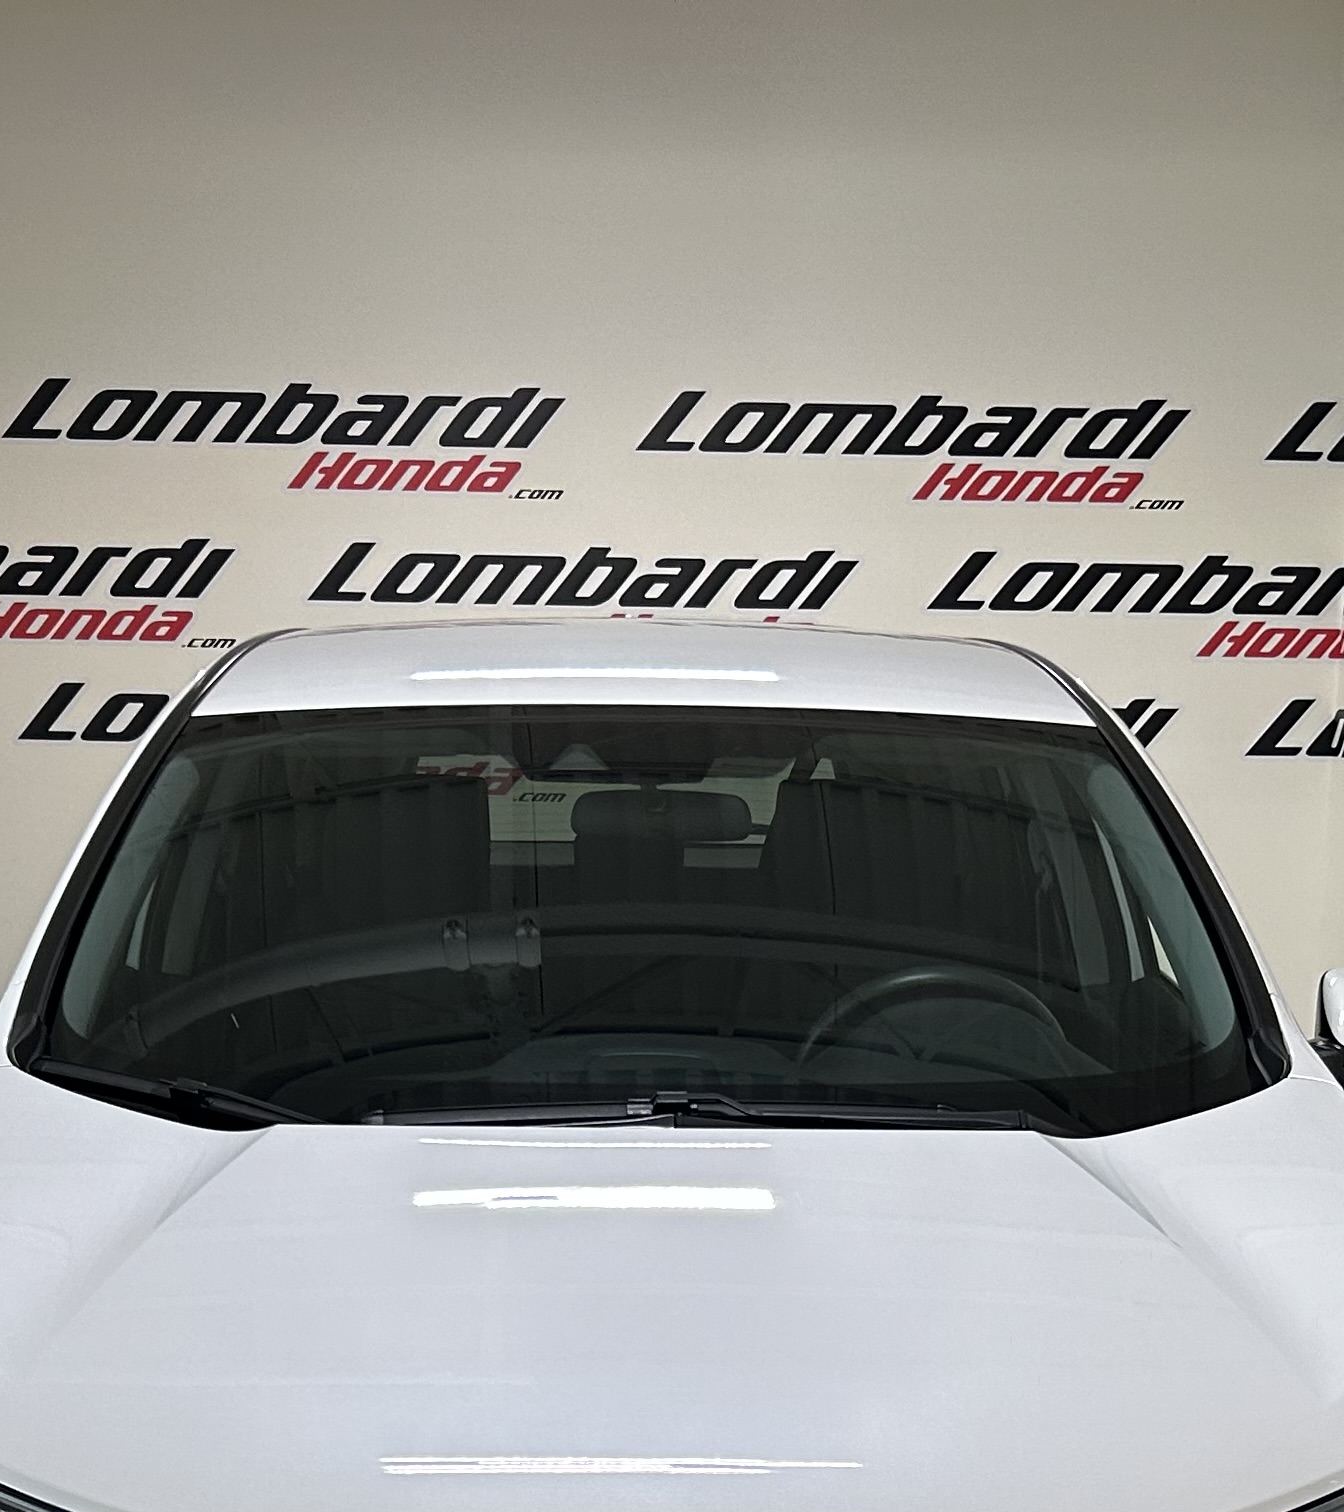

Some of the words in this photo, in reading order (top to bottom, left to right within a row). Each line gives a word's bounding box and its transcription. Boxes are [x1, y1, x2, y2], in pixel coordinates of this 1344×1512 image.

[2, 378, 566, 448] Lombardi
[636, 391, 1192, 459] Lombardi
[288, 452, 522, 493] Honda
[509, 489, 564, 499] .com
[913, 463, 1145, 503] Honda
[1129, 499, 1185, 510] .com
[308, 542, 860, 609] Lombardi
[181, 637, 236, 649] .com
[18, 683, 169, 742] Lo
